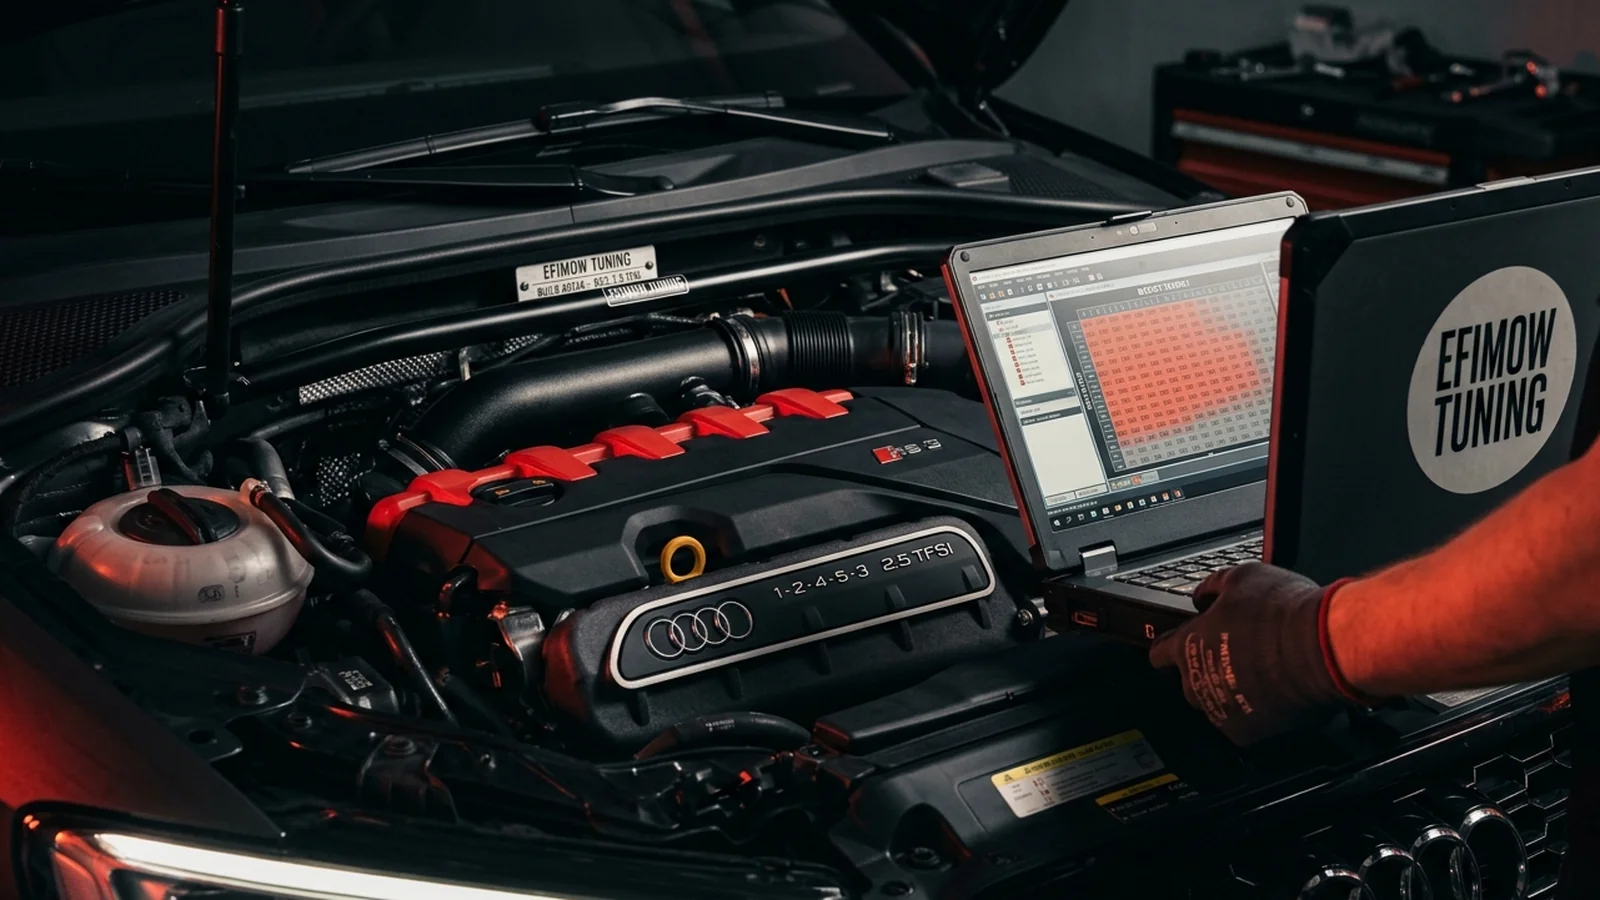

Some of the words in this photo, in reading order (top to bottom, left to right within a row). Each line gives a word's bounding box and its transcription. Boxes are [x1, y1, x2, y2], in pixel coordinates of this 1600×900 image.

[543, 259, 587, 279] EFIMOW
[591, 252, 631, 271] TUNING
[1435, 307, 1557, 392] EFIMOW
[1434, 372, 1547, 457] TUNING
[773, 563, 870, 600] 1-2-4-5-3
[880, 552, 912, 573] 2.5
[912, 542, 954, 564] TFSI
